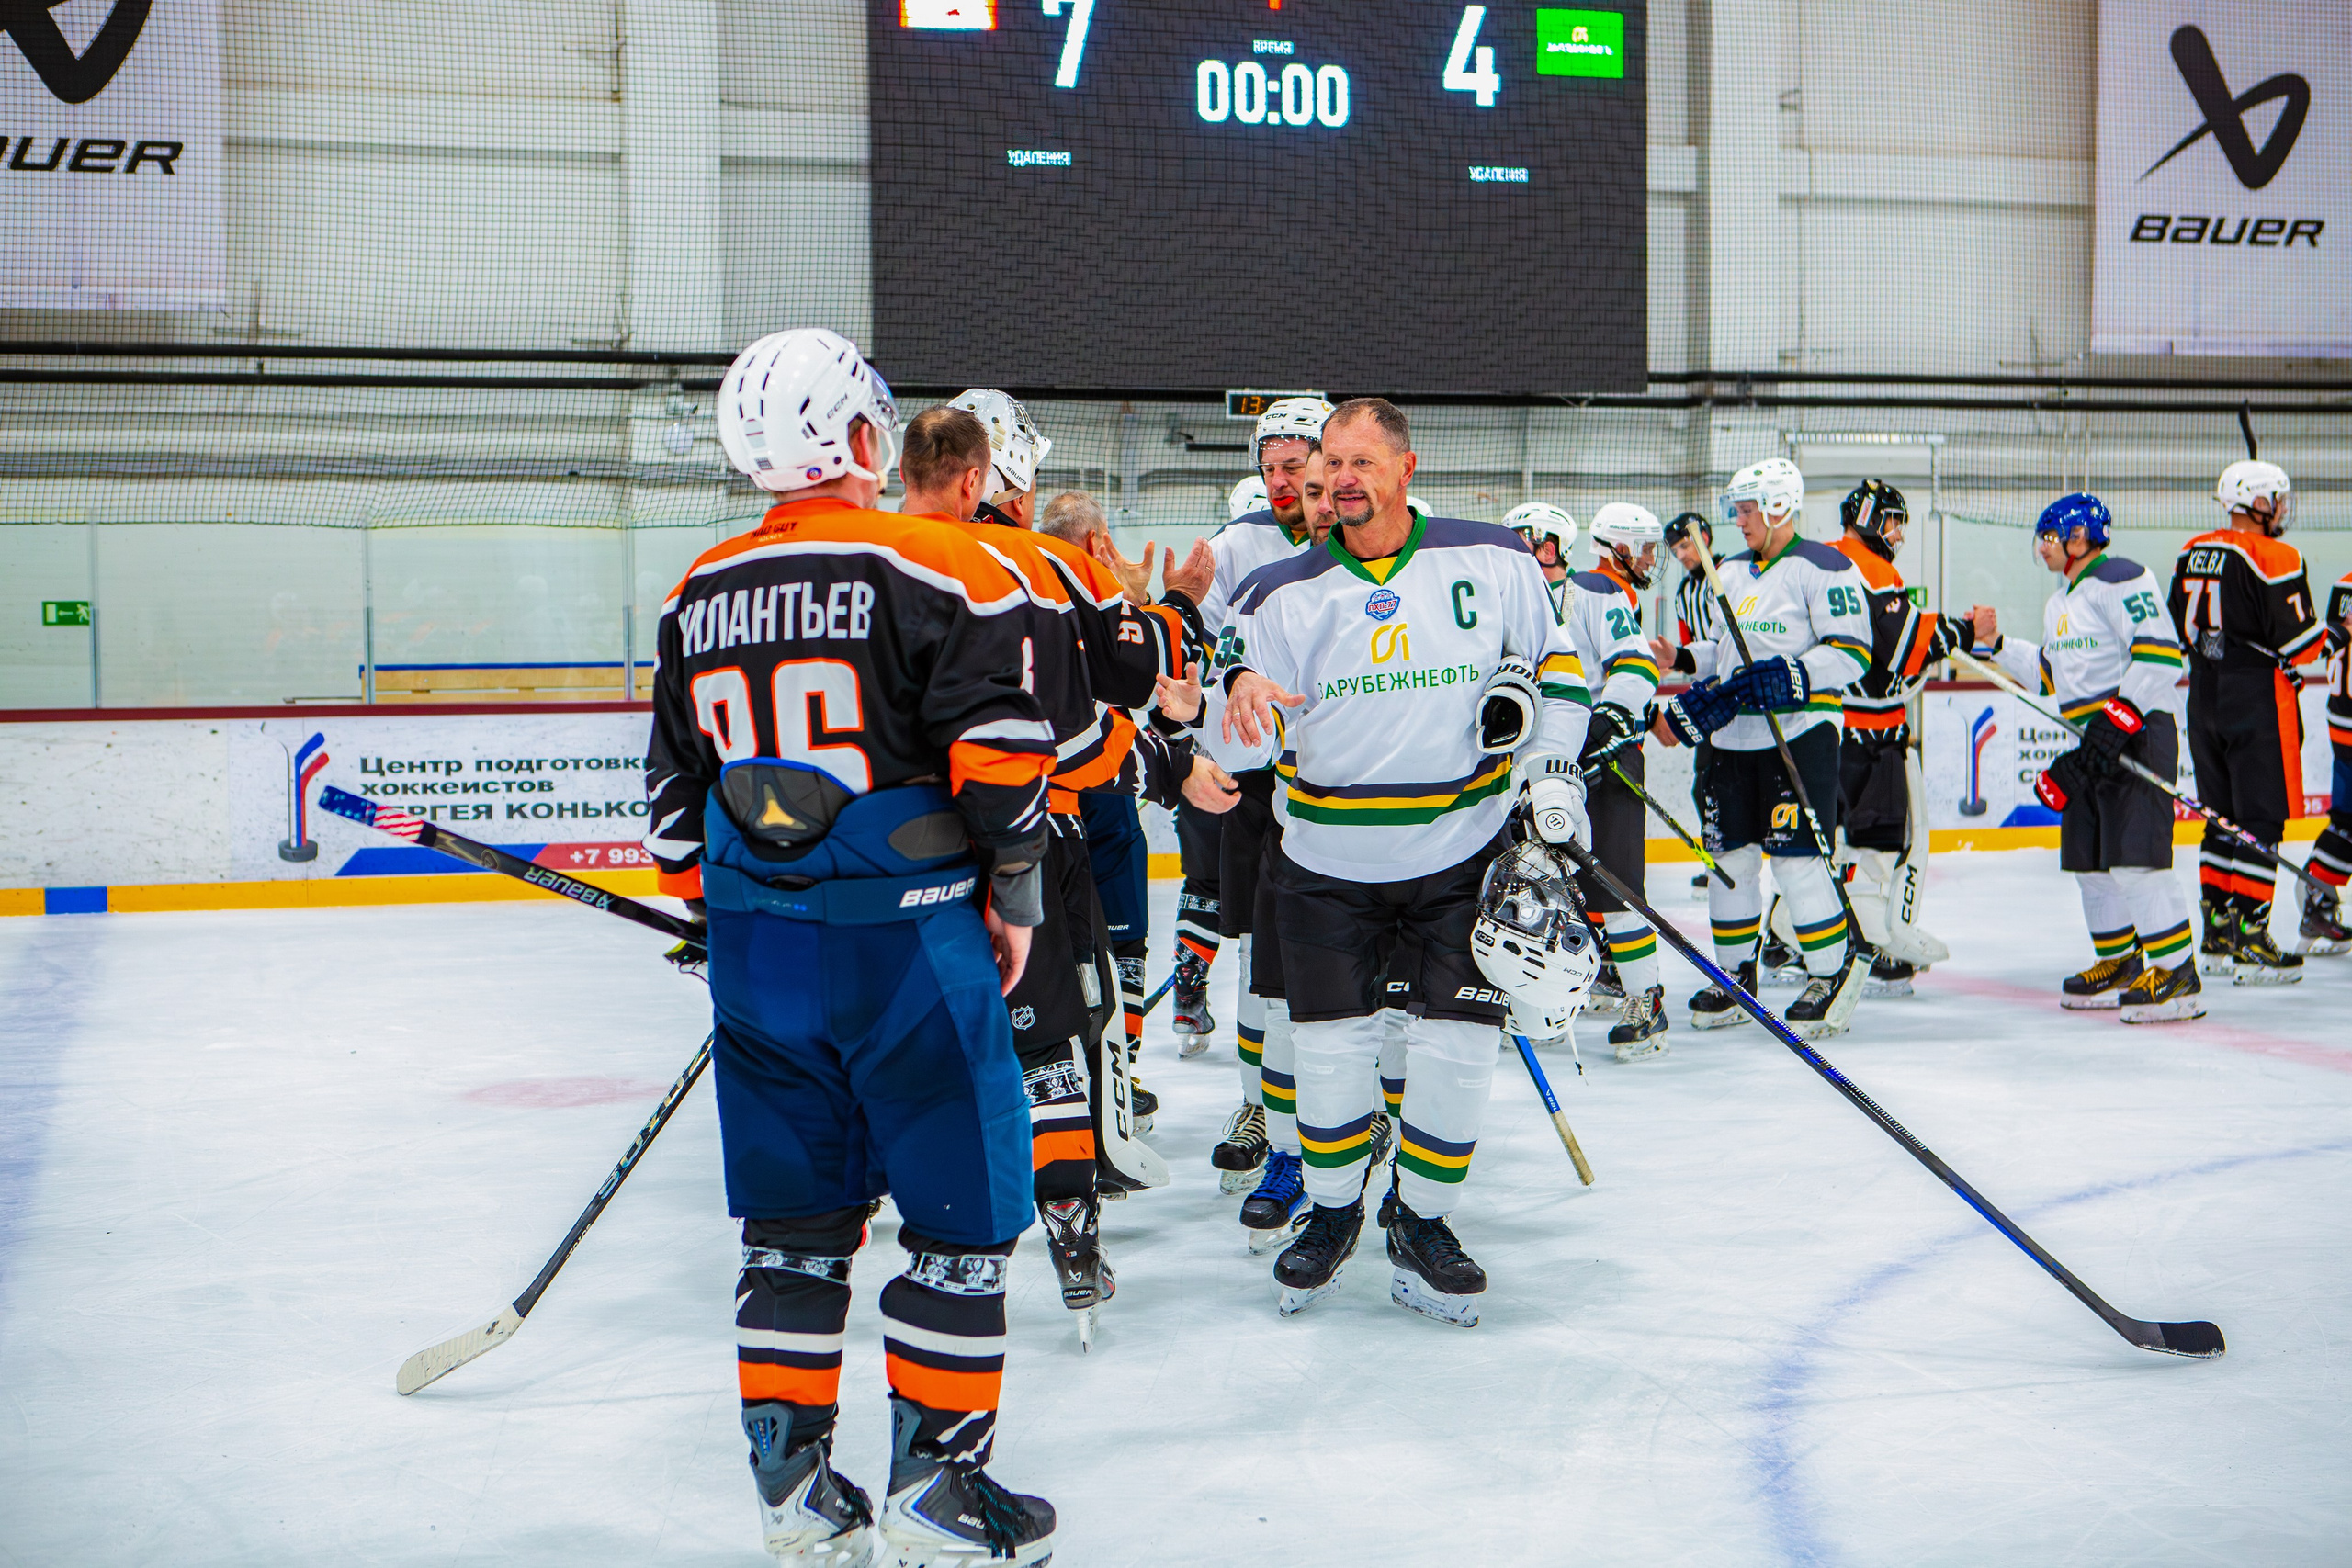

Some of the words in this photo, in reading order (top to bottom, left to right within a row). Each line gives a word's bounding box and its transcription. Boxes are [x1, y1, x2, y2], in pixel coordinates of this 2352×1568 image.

[1042, 0, 1096, 88] 7
[1442, 5, 1501, 107] 4
[1197, 60, 1350, 127] 00:00
[0, 135, 184, 175] UER
[2130, 214, 2325, 248] BAUER
[678, 581, 876, 658] ИЛАНТЬЕВ
[1451, 580, 1478, 630] C
[1827, 586, 1862, 617] 95
[2123, 591, 2159, 624] 55
[2182, 578, 2223, 646] 71
[2018, 728, 2068, 744] Цен
[360, 757, 463, 776] Центр
[475, 757, 648, 774] подготовк
[360, 781, 554, 795] хоккеистов
[391, 804, 492, 821] РГЕЯ
[506, 801, 650, 819] КОНЬКО
[570, 849, 600, 864] +7
[899, 877, 977, 908] BAUER
[1902, 863, 1917, 925] CCM
[1106, 1040, 1129, 1142] CCM
